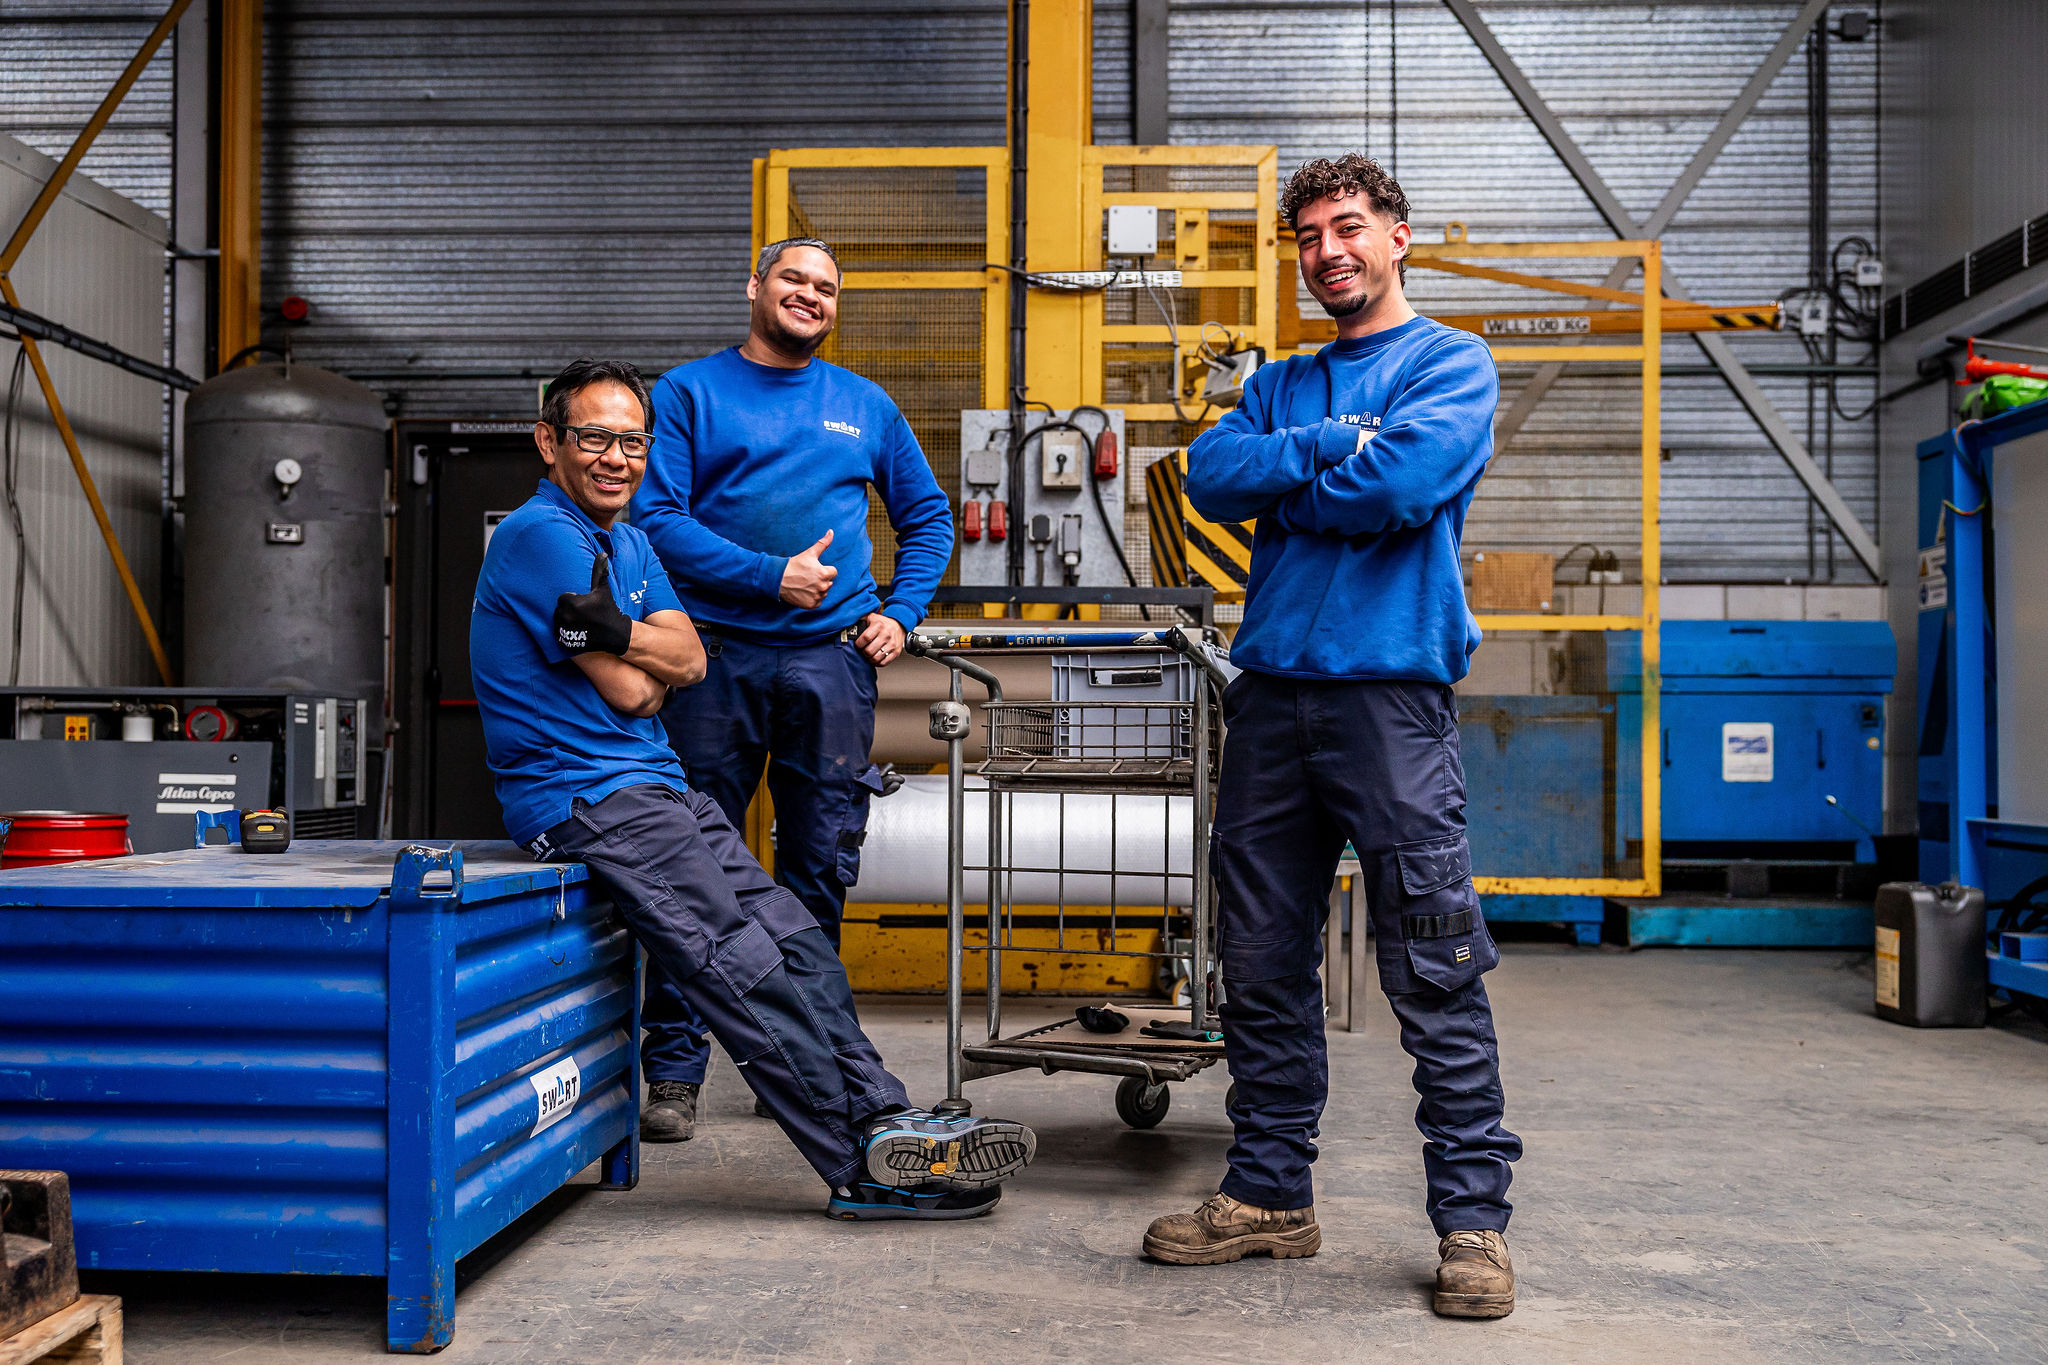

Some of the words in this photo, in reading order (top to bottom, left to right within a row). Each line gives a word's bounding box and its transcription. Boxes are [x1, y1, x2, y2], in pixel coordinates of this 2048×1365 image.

[1486, 319, 1523, 334] WLL
[1528, 318, 1559, 333] 100
[1564, 317, 1589, 332] KG
[1338, 411, 1382, 426] SWAR
[157, 786, 198, 799] Atlas
[199, 786, 236, 803] Copco
[541, 1075, 578, 1116] SWART
